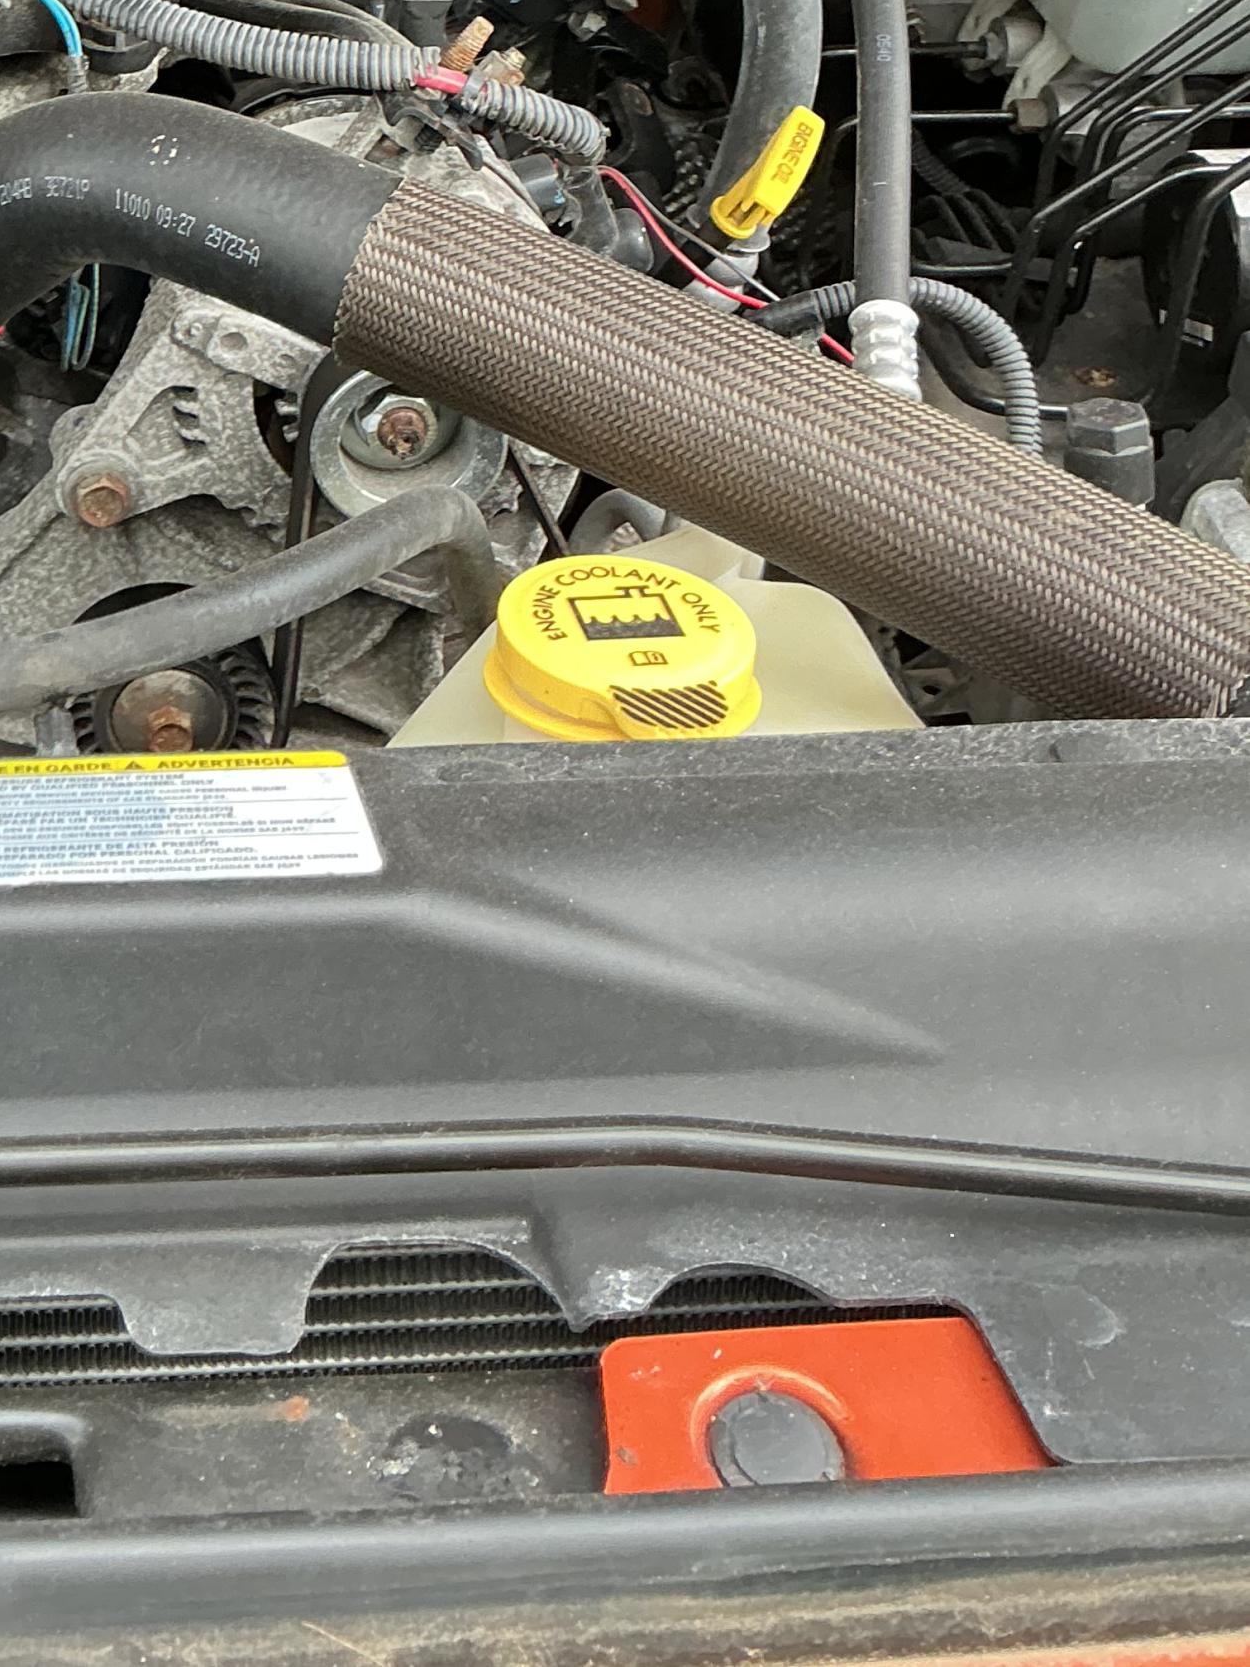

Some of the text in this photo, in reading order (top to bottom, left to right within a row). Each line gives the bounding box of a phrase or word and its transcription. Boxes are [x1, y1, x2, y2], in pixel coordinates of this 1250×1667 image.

[155, 203, 197, 238] 09:27
[204, 223, 261, 268] 29723-A
[532, 565, 721, 642] ENGINE COOLANT ONLY
[13, 764, 40, 774] EN
[44, 762, 112, 773] GARDE
[156, 756, 294, 770] ADVERTENCIA
